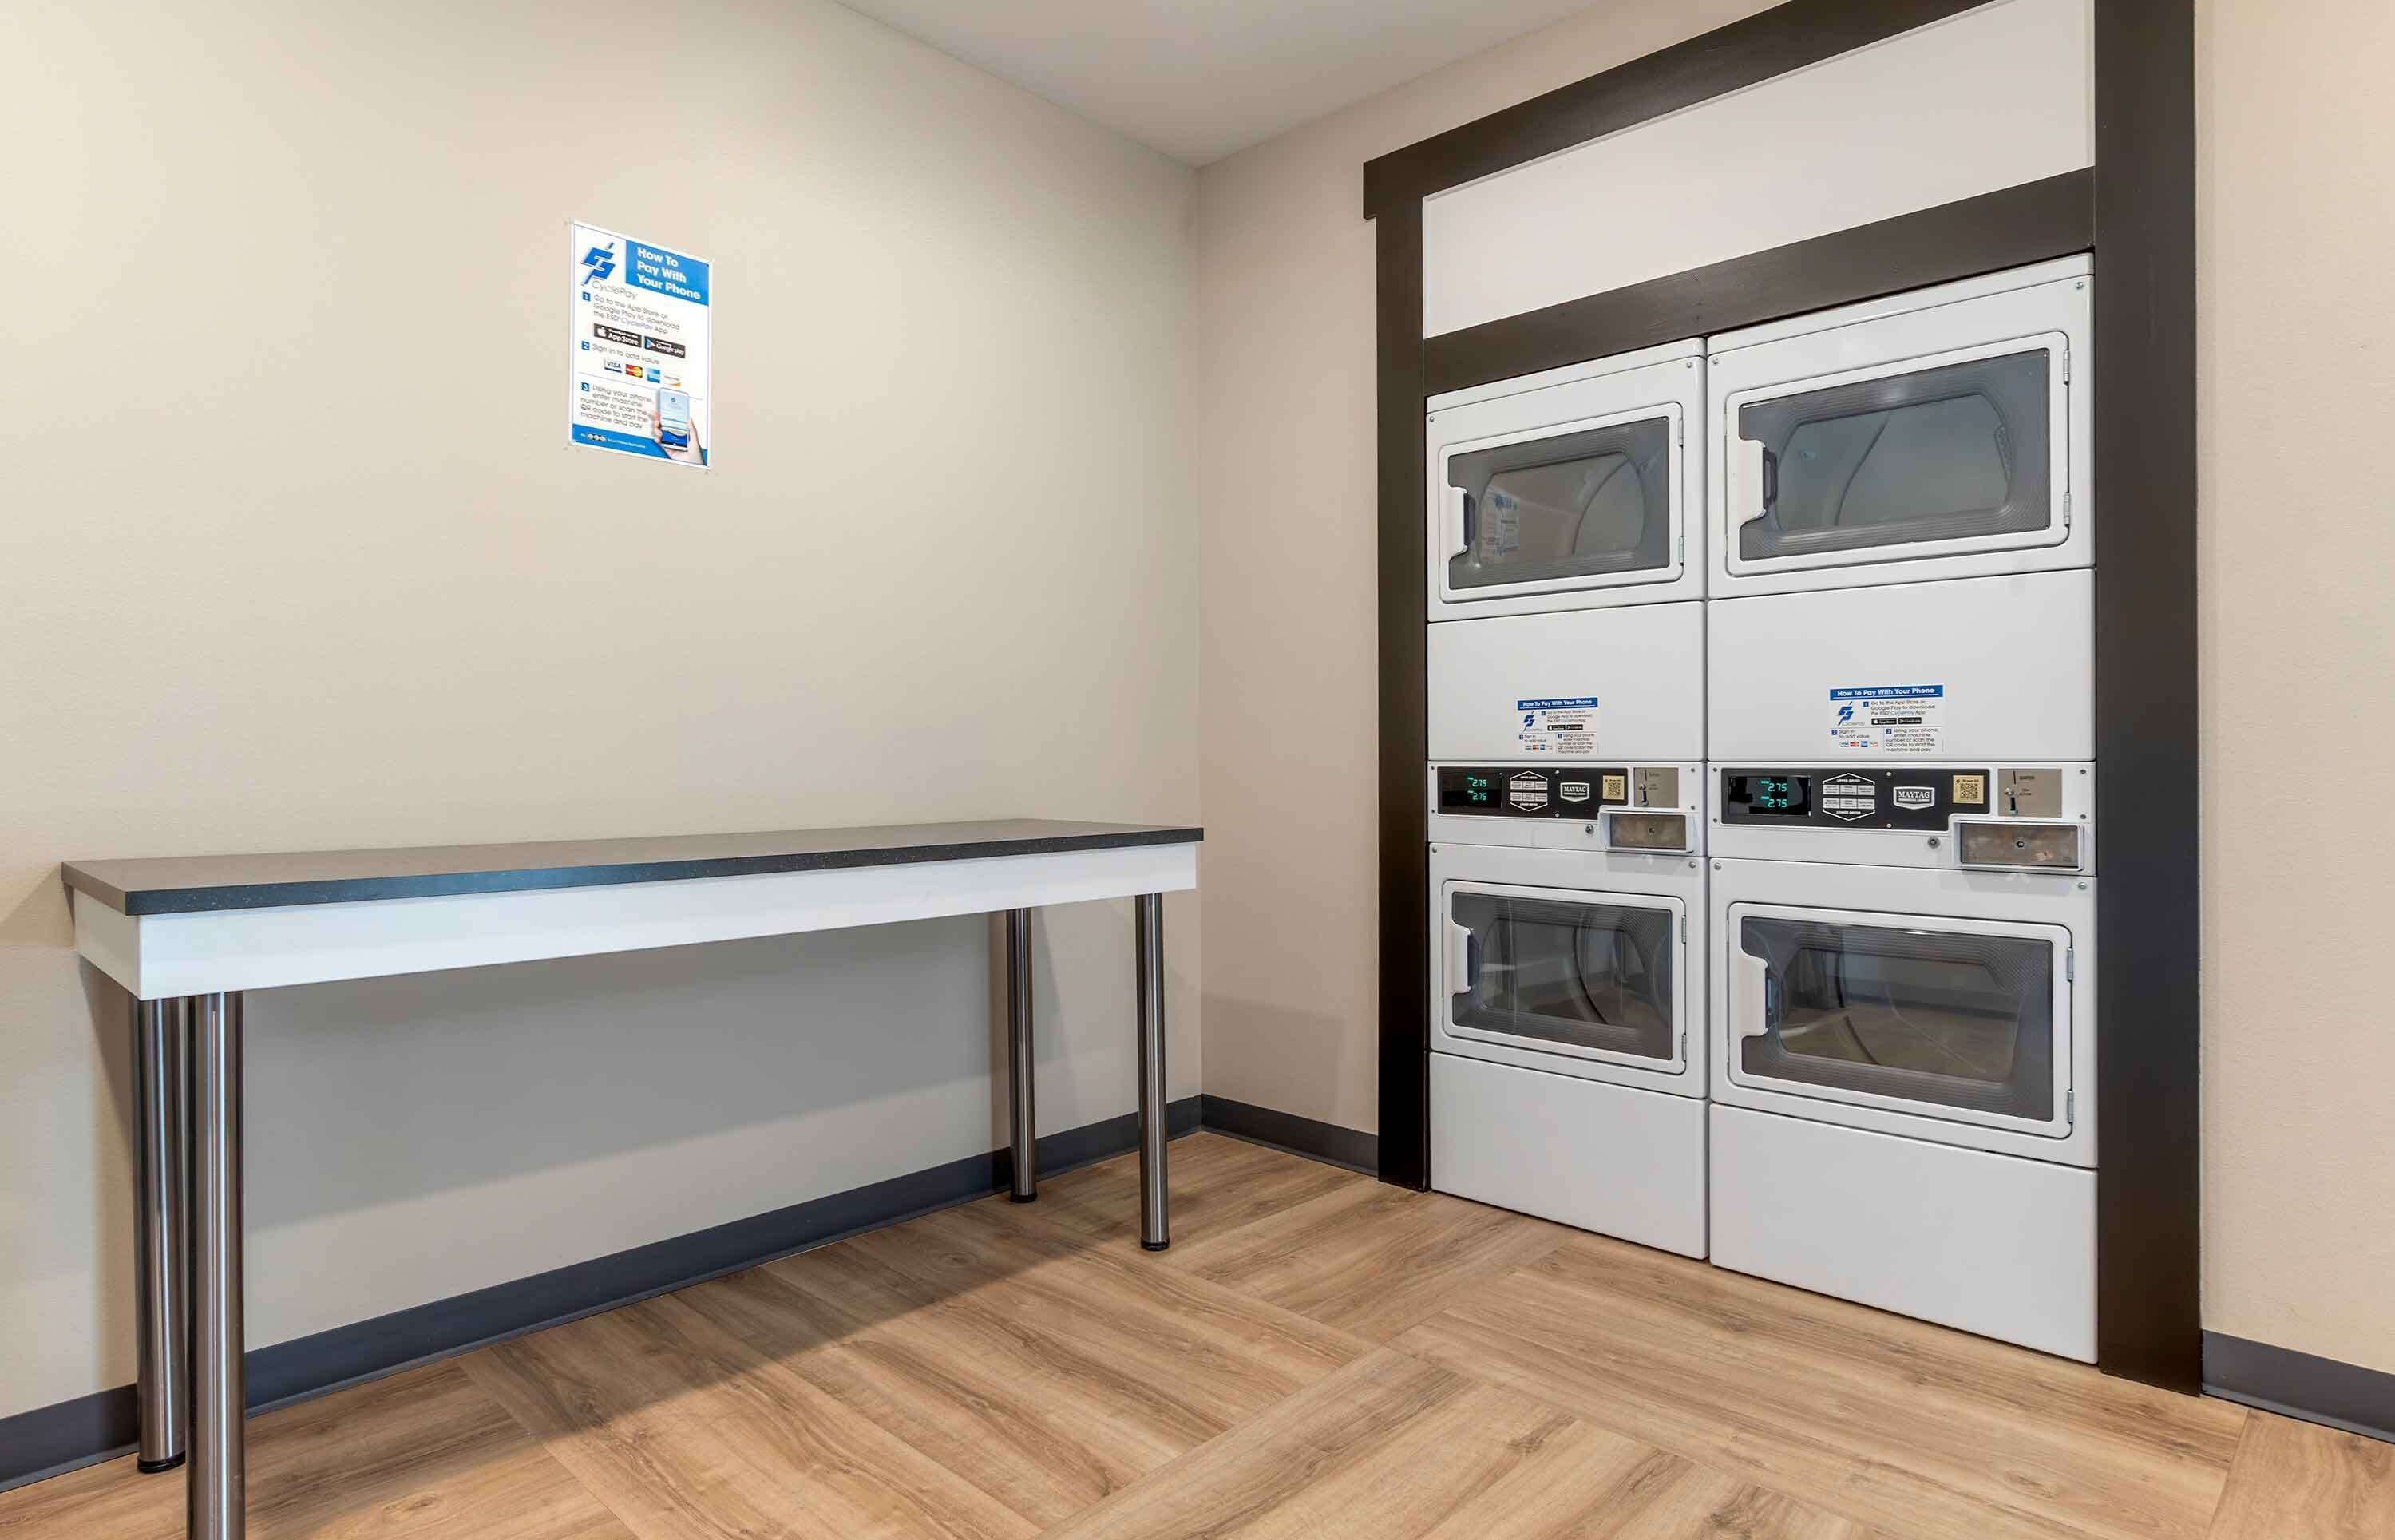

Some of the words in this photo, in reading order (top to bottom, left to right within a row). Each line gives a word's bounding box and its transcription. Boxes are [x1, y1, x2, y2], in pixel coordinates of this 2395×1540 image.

[637, 247, 663, 263] How
[666, 255, 679, 268] To
[636, 261, 659, 277] Pay
[662, 267, 687, 283] With
[592, 281, 638, 300] CyclePay
[637, 274, 663, 290] Your
[665, 283, 701, 300] Phone
[594, 303, 620, 314] Google
[623, 309, 635, 319] Play
[646, 317, 680, 330] download
[643, 307, 659, 316] Store
[608, 333, 621, 342] App
[622, 336, 639, 345] Store
[656, 343, 674, 352] Google
[592, 343, 608, 353] Sign
[642, 355, 659, 365] value
[592, 384, 612, 395] Using
[581, 398, 608, 406] number
[612, 397, 643, 407] machine
[581, 412, 612, 422] machine
